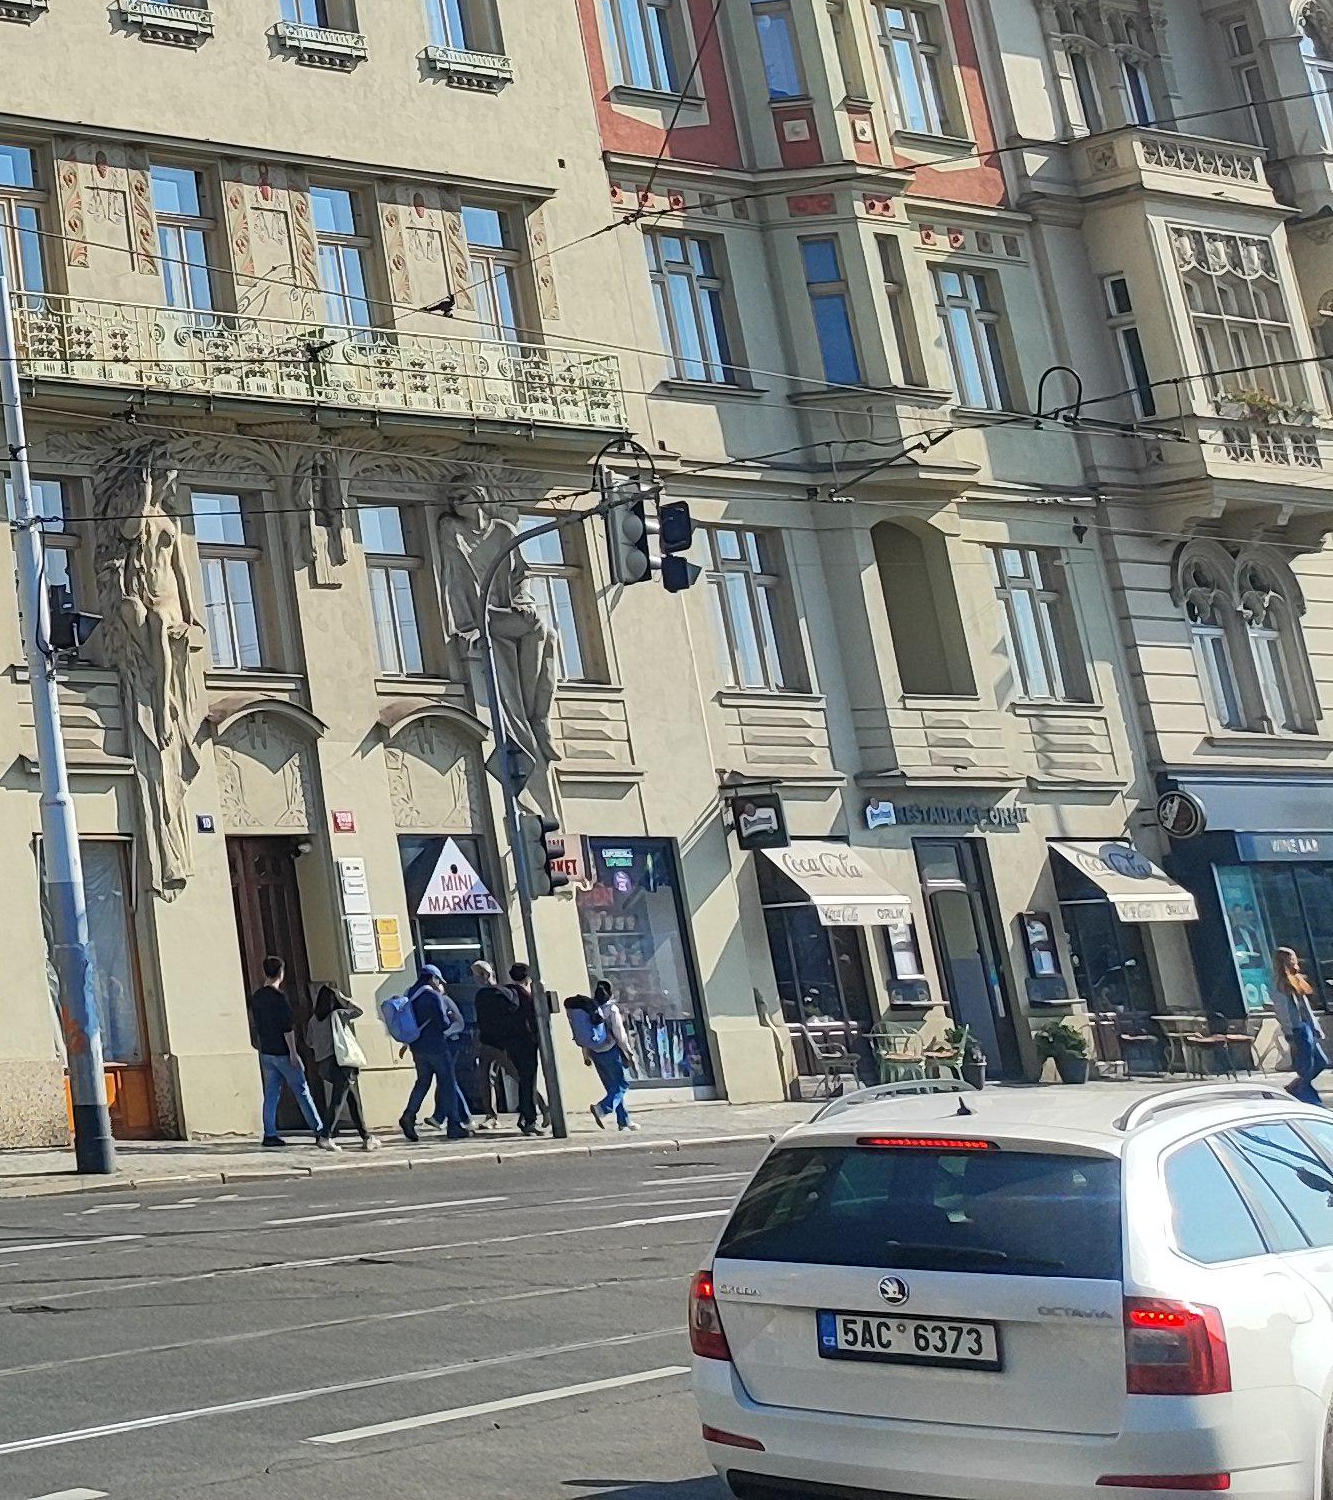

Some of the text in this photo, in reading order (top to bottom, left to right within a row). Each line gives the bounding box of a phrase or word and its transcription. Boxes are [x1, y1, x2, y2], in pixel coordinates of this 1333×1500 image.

[441, 874, 474, 892] MINI
[427, 893, 497, 912] MARKET
[842, 1318, 984, 1357] 5AC 6373
